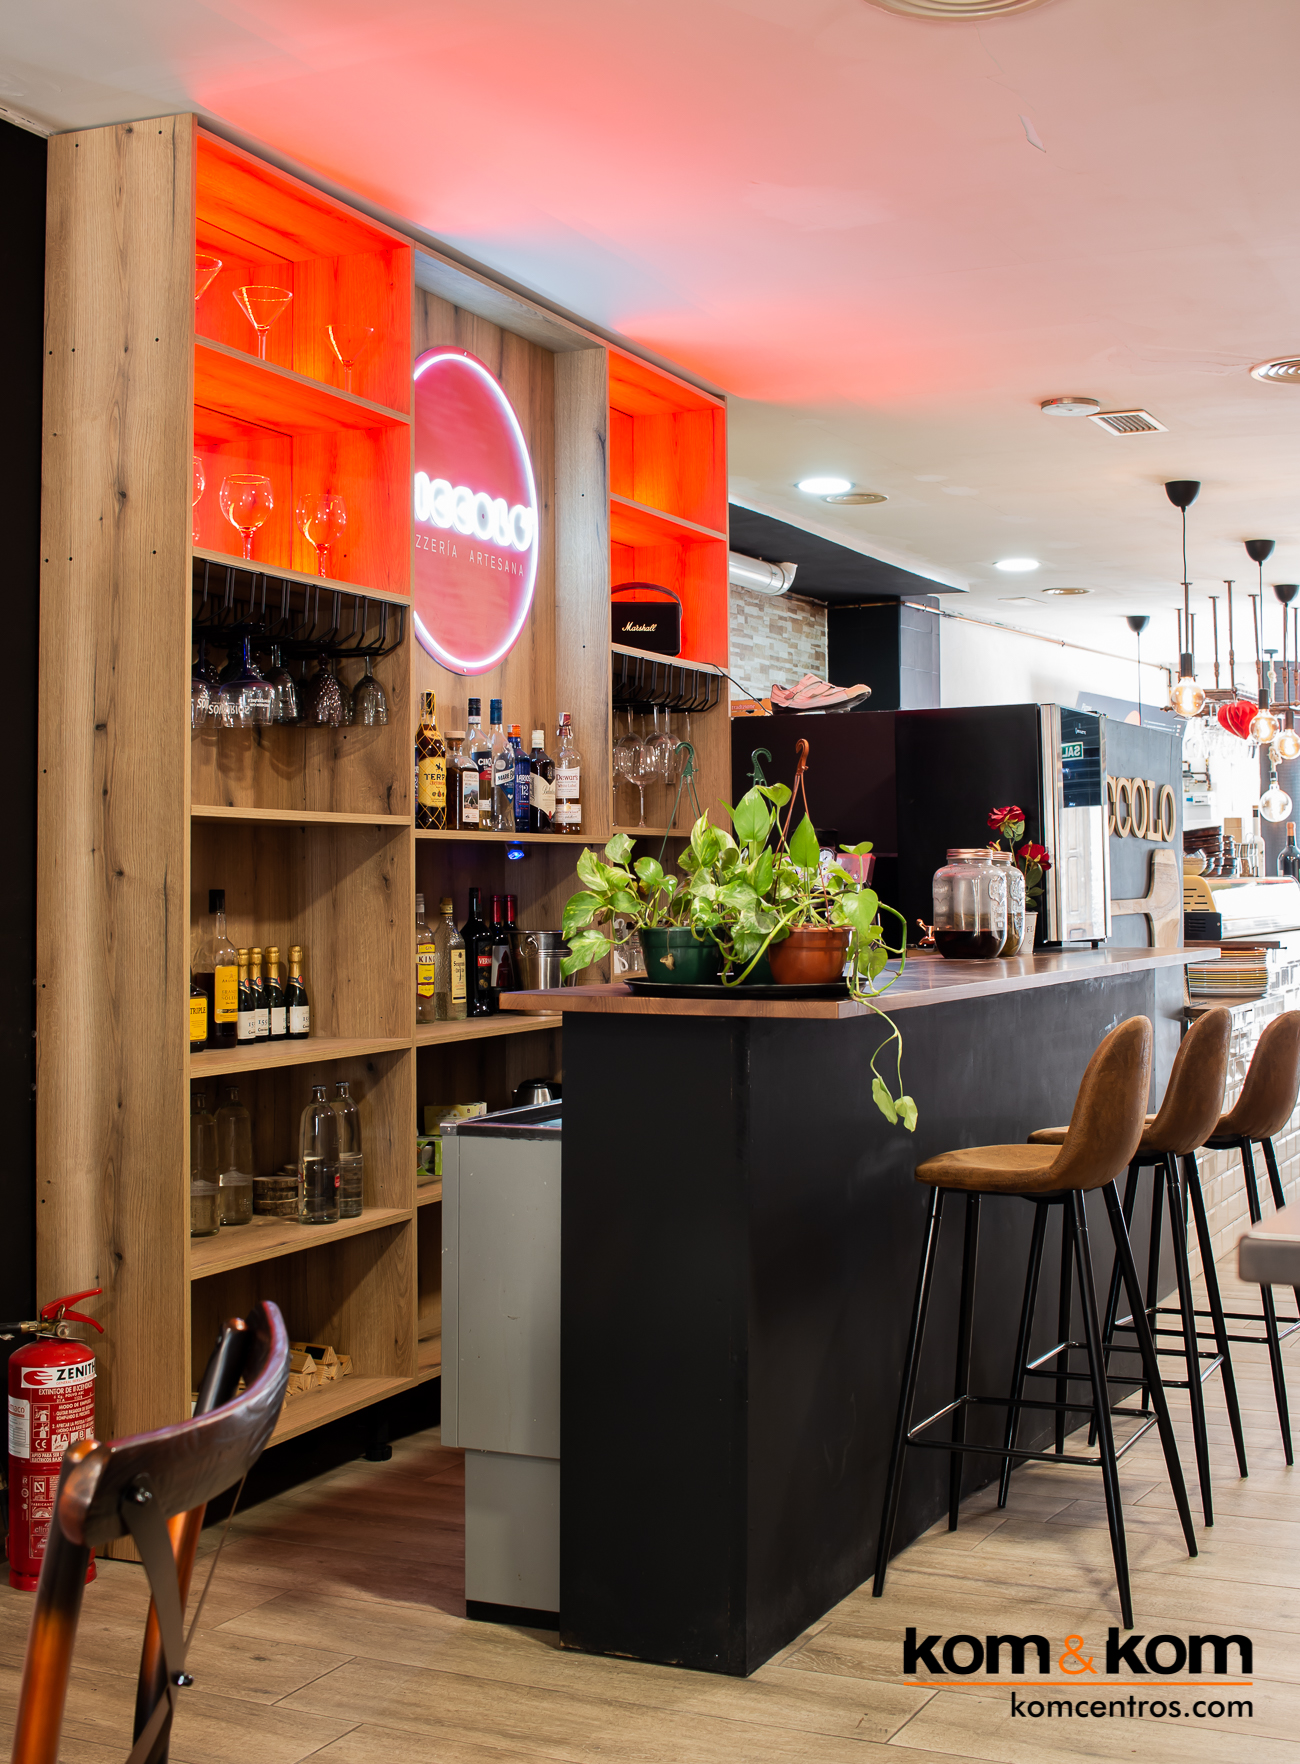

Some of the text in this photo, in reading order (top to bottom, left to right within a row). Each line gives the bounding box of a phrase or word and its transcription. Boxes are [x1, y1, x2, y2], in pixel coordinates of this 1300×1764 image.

[469, 550, 524, 577] ARTESANA
[621, 621, 657, 632] Marshall
[38, 1387, 64, 1395] EXTINTOR
